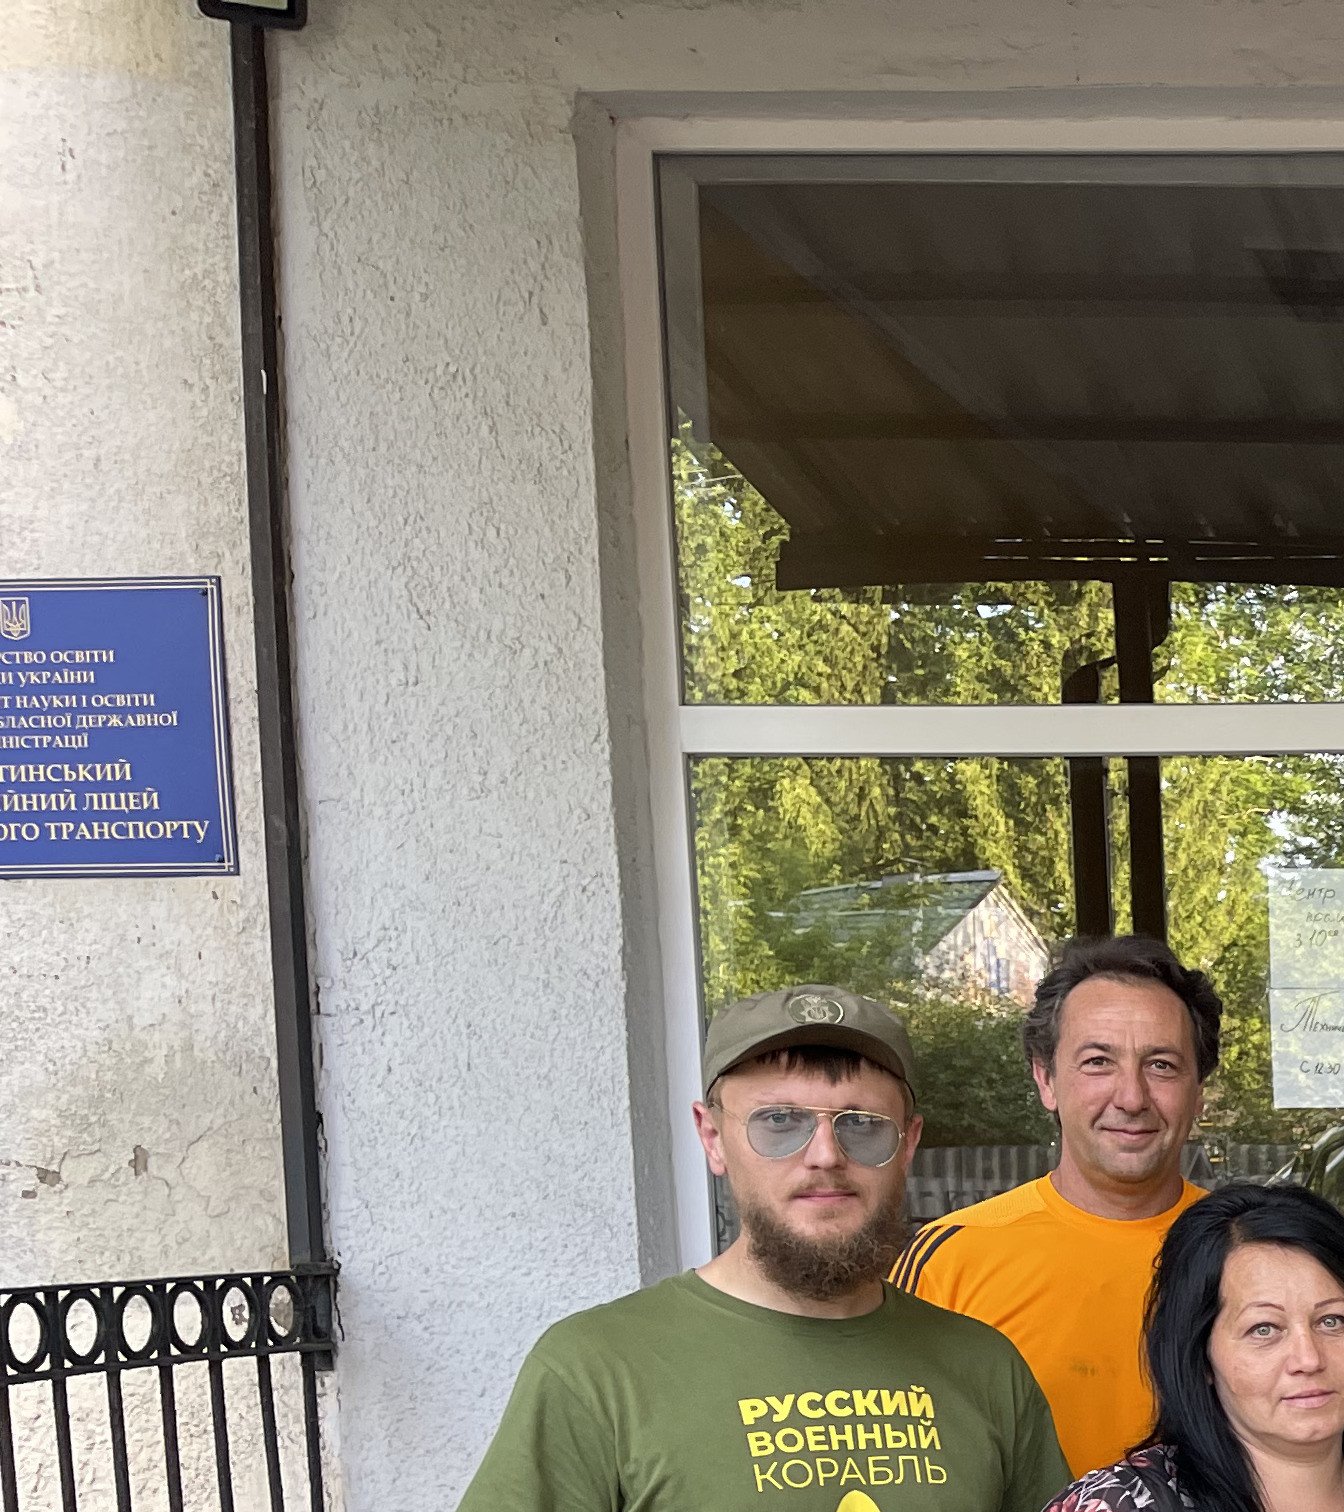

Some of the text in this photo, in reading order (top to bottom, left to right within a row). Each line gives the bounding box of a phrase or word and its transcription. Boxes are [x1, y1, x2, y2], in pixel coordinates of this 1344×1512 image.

[50, 650, 115, 664] ОСВІТИ
[18, 668, 96, 688] УКРАЇНИ
[15, 694, 78, 711] НАУКИ
[91, 693, 156, 708] ОСВІТИ
[76, 711, 178, 729] ДЕРЖАВНОЇ
[0, 787, 160, 814] ЙНИЙ ЛІЦЕЙ
[44, 819, 210, 843] ТРАНСПОРТУ
[738, 1385, 935, 1426] РУССКИЙ
[747, 1420, 942, 1458] ВОЕННЫЙ
[753, 1455, 948, 1492] КОРАБЛЬ
